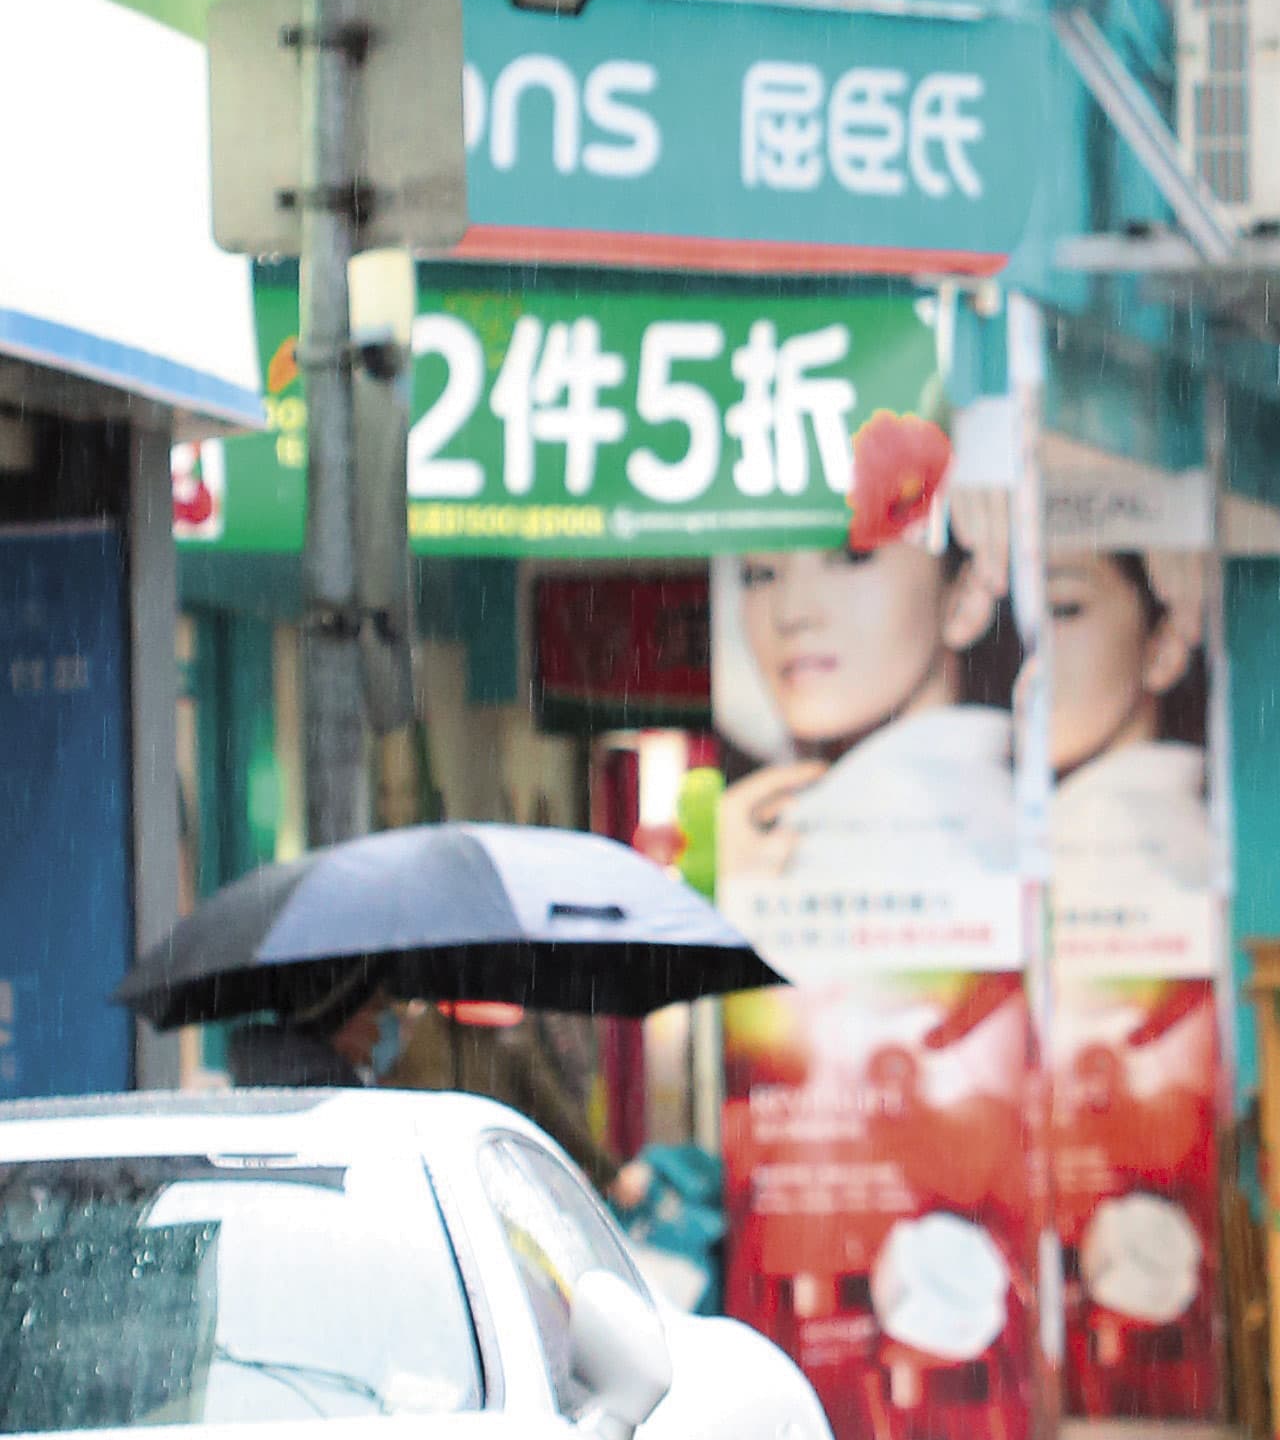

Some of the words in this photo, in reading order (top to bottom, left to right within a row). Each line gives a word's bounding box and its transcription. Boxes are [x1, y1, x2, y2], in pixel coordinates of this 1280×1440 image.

[740, 60, 985, 198] 屈臣氏
[407, 313, 856, 504] 2件5折
